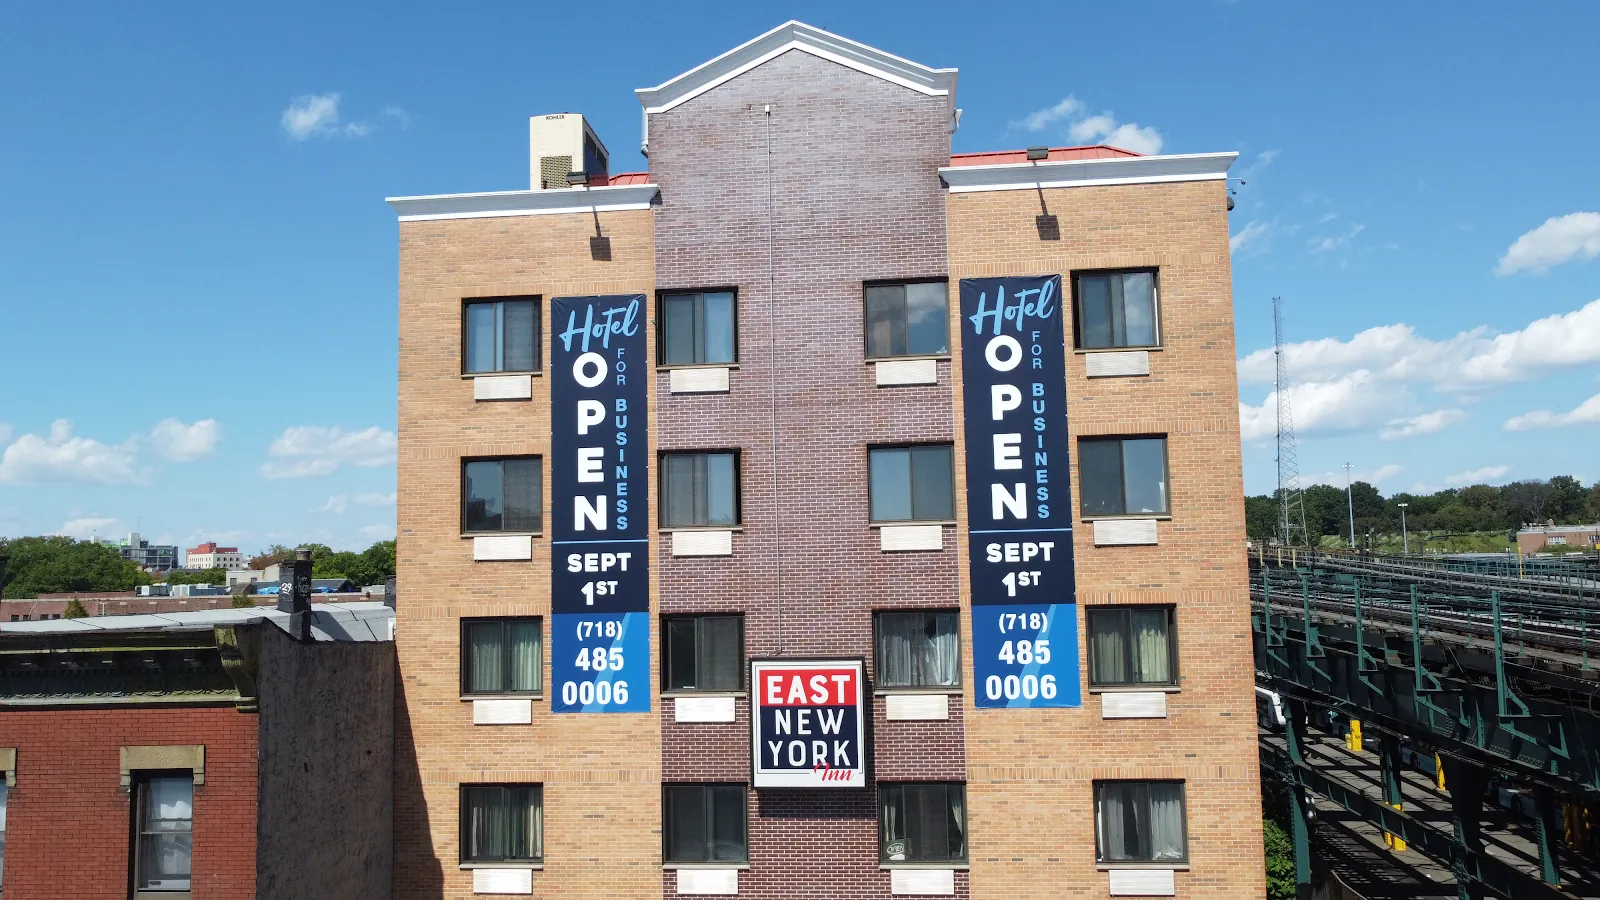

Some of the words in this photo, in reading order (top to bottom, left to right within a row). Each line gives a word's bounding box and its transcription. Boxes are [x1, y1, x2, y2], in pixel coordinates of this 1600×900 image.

[969, 280, 1054, 336] Hotel
[559, 299, 640, 352] Hotel
[1031, 331, 1043, 369] FOR
[616, 348, 627, 385] FOR
[985, 335, 1028, 520] OPEN
[572, 352, 608, 531] OPEN
[1032, 383, 1050, 519] BUSINESS
[615, 399, 628, 530] BUSINESS
[567, 552, 632, 573] SEPT
[986, 541, 1055, 563] SEPT
[580, 580, 619, 606] 1ST
[1001, 571, 1042, 597] 1ST
[576, 620, 623, 641] (718)
[998, 612, 1048, 634] (718)
[574, 646, 625, 672] 485
[998, 639, 1051, 665] 485
[561, 680, 629, 706] 0006
[766, 674, 851, 705] EAST
[985, 674, 1058, 701] 0006
[774, 708, 845, 735] NEW
[767, 740, 851, 767] YORK
[813, 761, 854, 781] Inn
